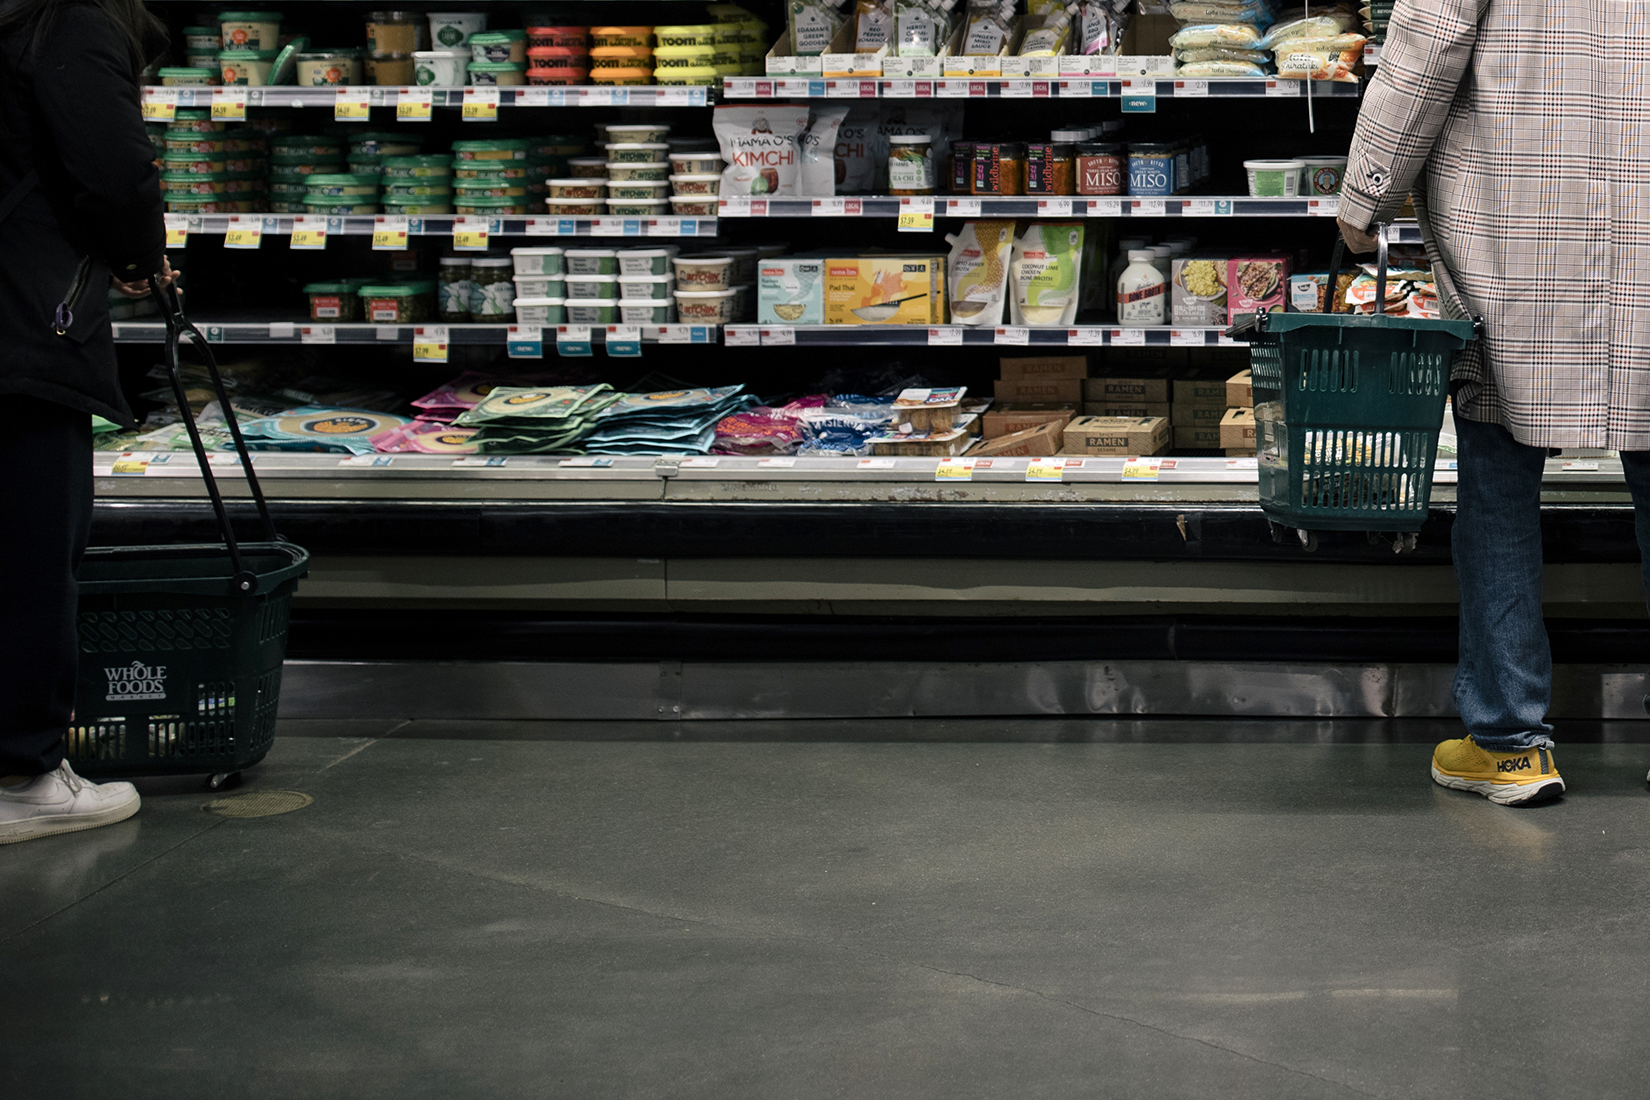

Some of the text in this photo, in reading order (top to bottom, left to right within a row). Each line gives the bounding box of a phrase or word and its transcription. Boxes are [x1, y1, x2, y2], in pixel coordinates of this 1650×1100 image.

[730, 135, 794, 147] MAMA O'S
[732, 150, 794, 167] KIMCHI
[990, 146, 1000, 191] wildbrine
[1042, 146, 1052, 191] wildbrine
[1085, 171, 1121, 186] MISO
[1130, 173, 1167, 187] MISO
[1128, 290, 1143, 302] BONE
[1144, 285, 1161, 298] BROTH
[1107, 385, 1142, 395] RAMEN
[1089, 437, 1125, 447] RAMEN
[104, 666, 167, 680] WHOLE
[108, 680, 163, 694] FOODS
[1497, 756, 1531, 773] HOKA
